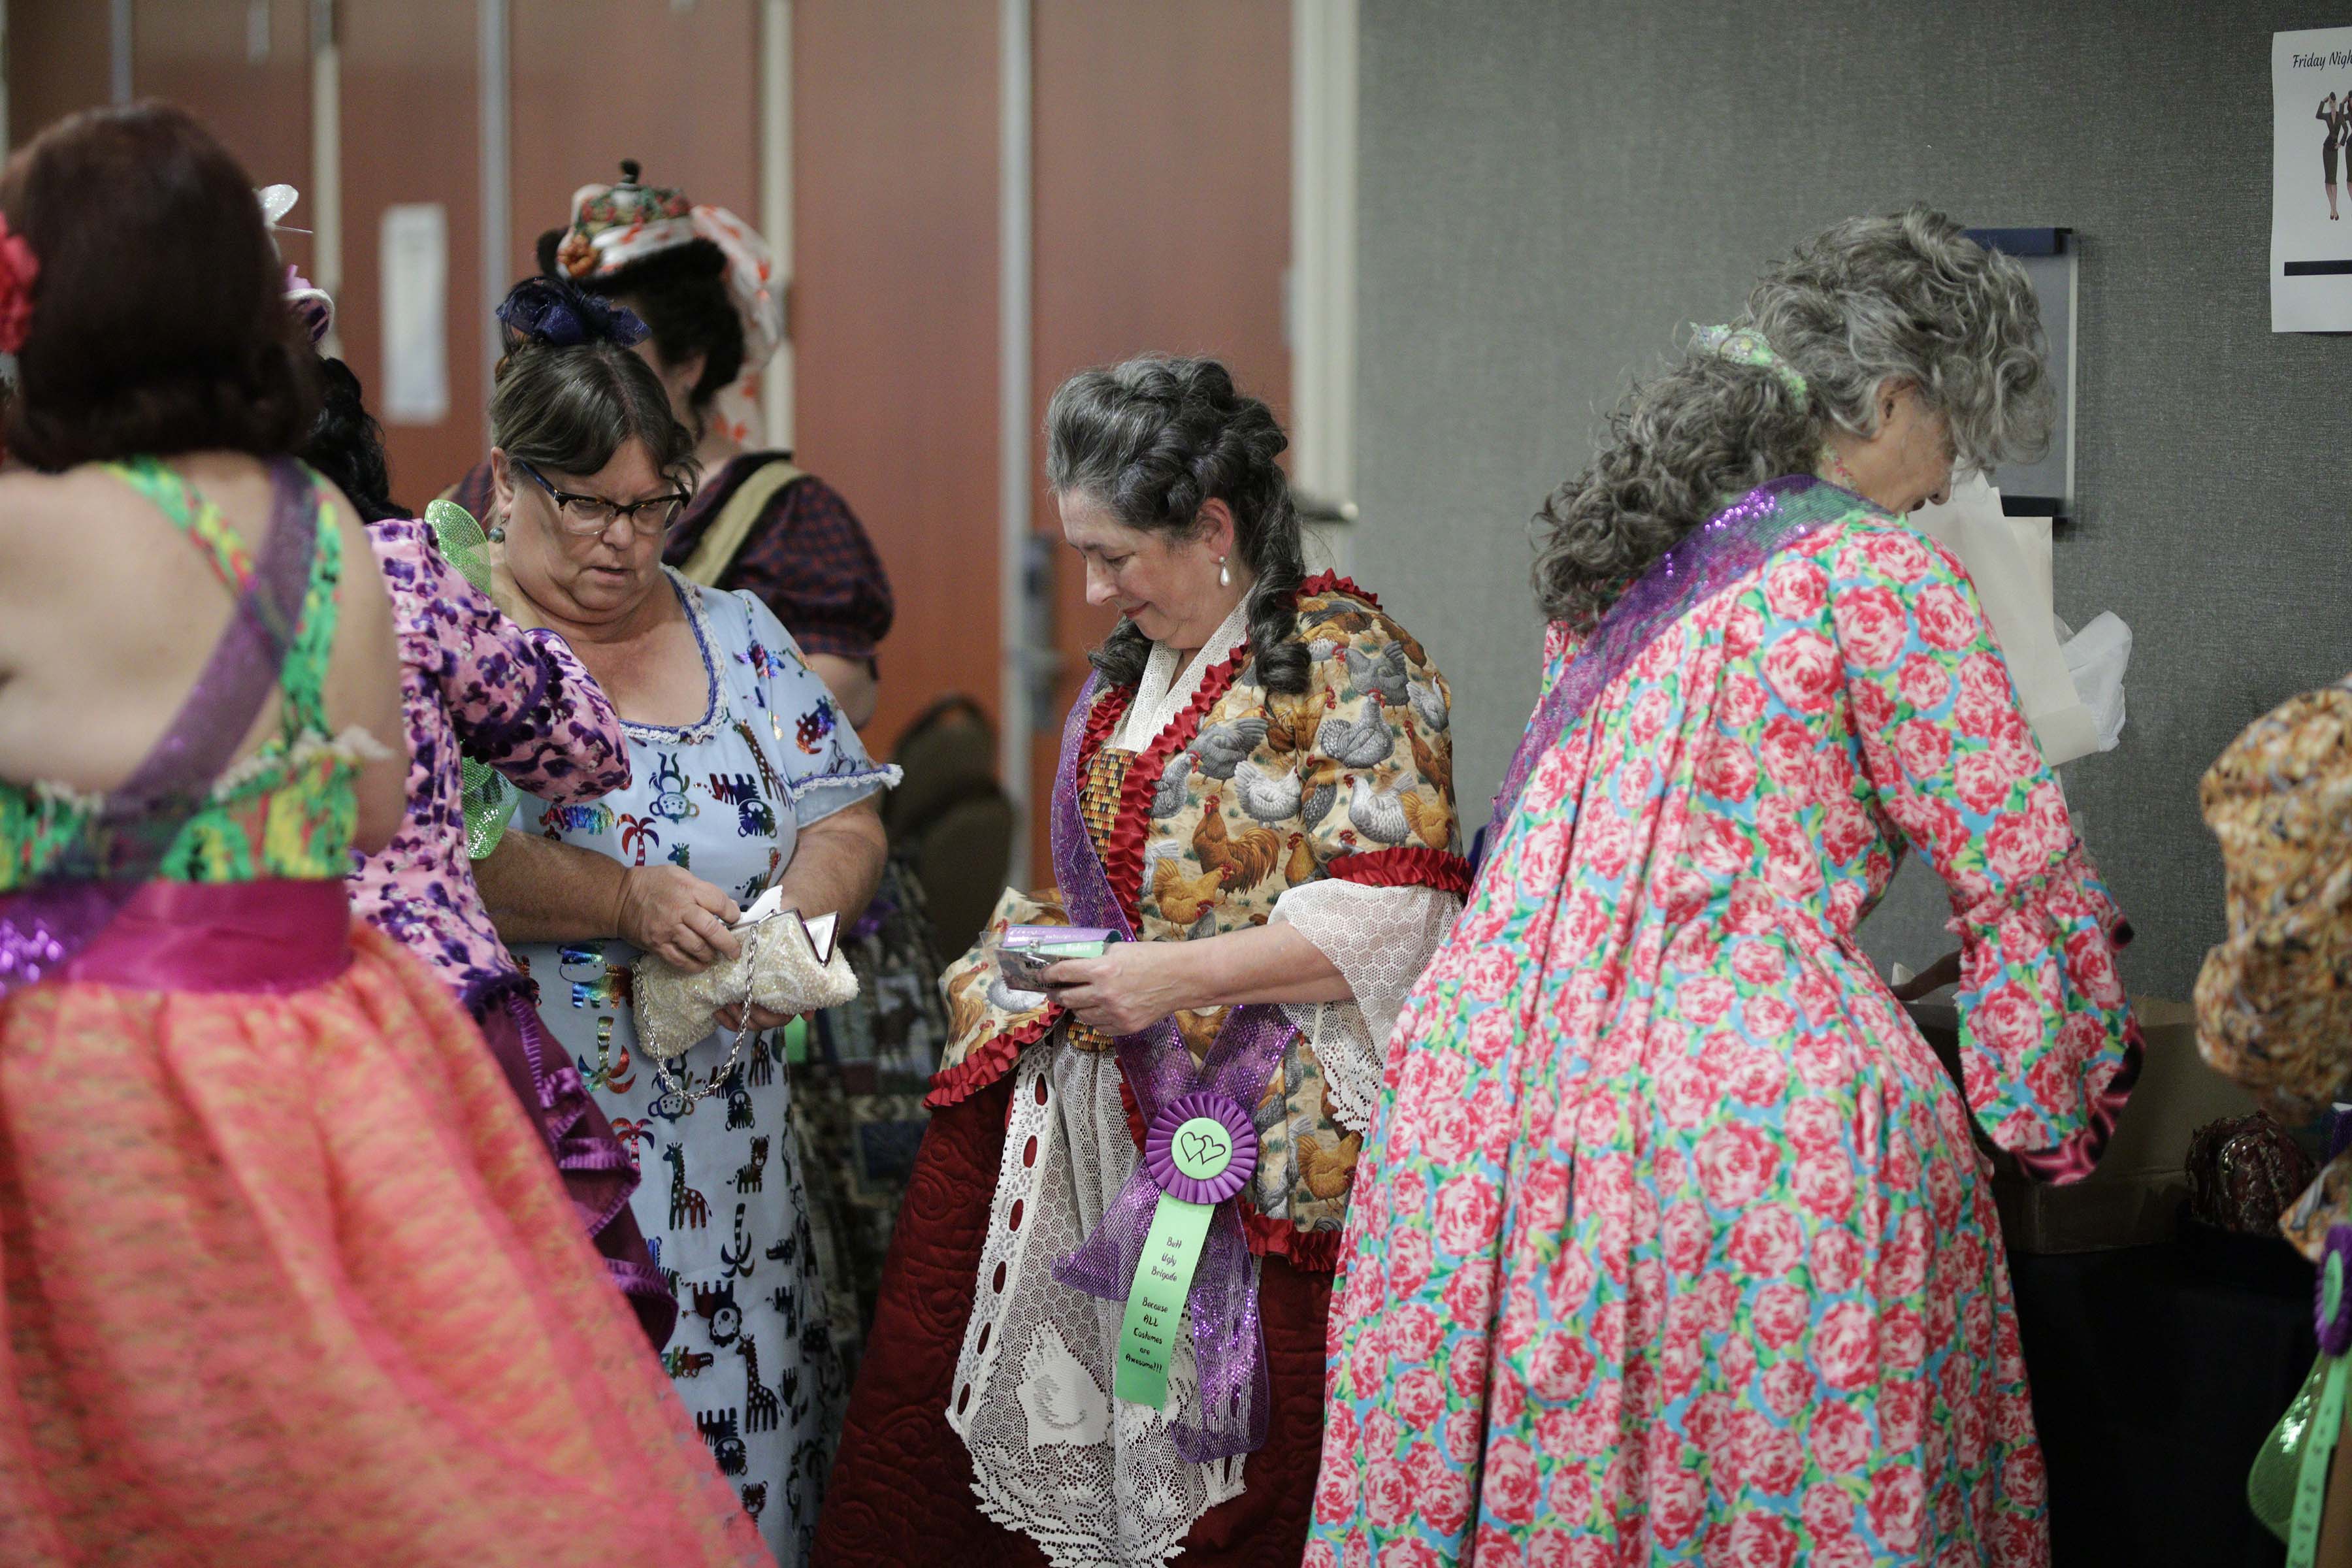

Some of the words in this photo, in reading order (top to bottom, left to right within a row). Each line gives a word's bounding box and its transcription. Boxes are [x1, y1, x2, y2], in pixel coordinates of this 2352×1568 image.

[2293, 52, 2326, 71] Friday
[1167, 1237, 1182, 1249] Butt
[1162, 1252, 1177, 1267] Ugly
[1151, 1266, 1177, 1282] Brigade
[1142, 1296, 1168, 1313] Because
[1143, 1314, 1158, 1327] ALL
[1134, 1327, 1162, 1344] Costumes
[1125, 1353, 1162, 1373] Awesome!!!
